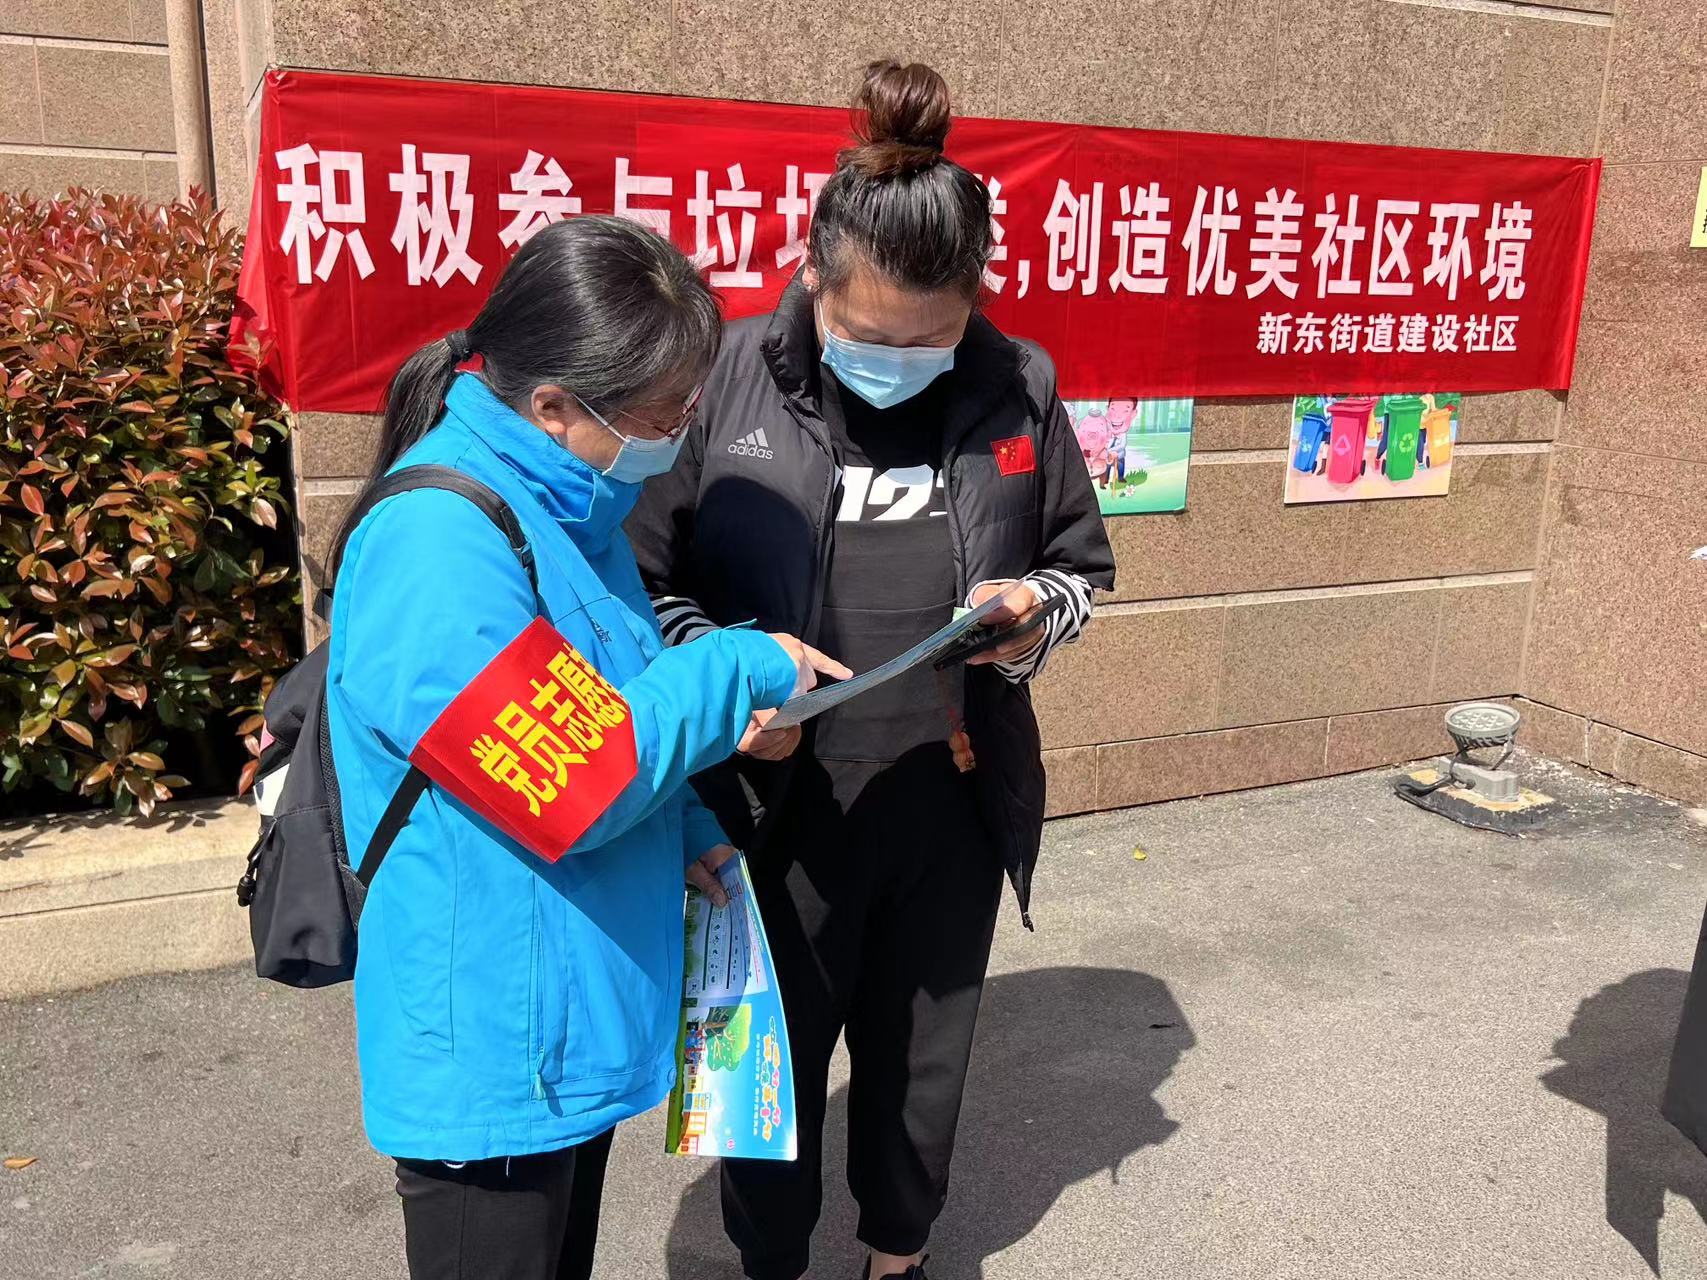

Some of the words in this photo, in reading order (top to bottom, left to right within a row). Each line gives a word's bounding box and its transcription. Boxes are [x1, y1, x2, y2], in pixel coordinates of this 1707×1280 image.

[275, 144, 1533, 301] 积极参与垃,创造优美社区环境
[1256, 312, 1519, 355] 新东街道建设社区
[727, 442, 774, 460] adidas
